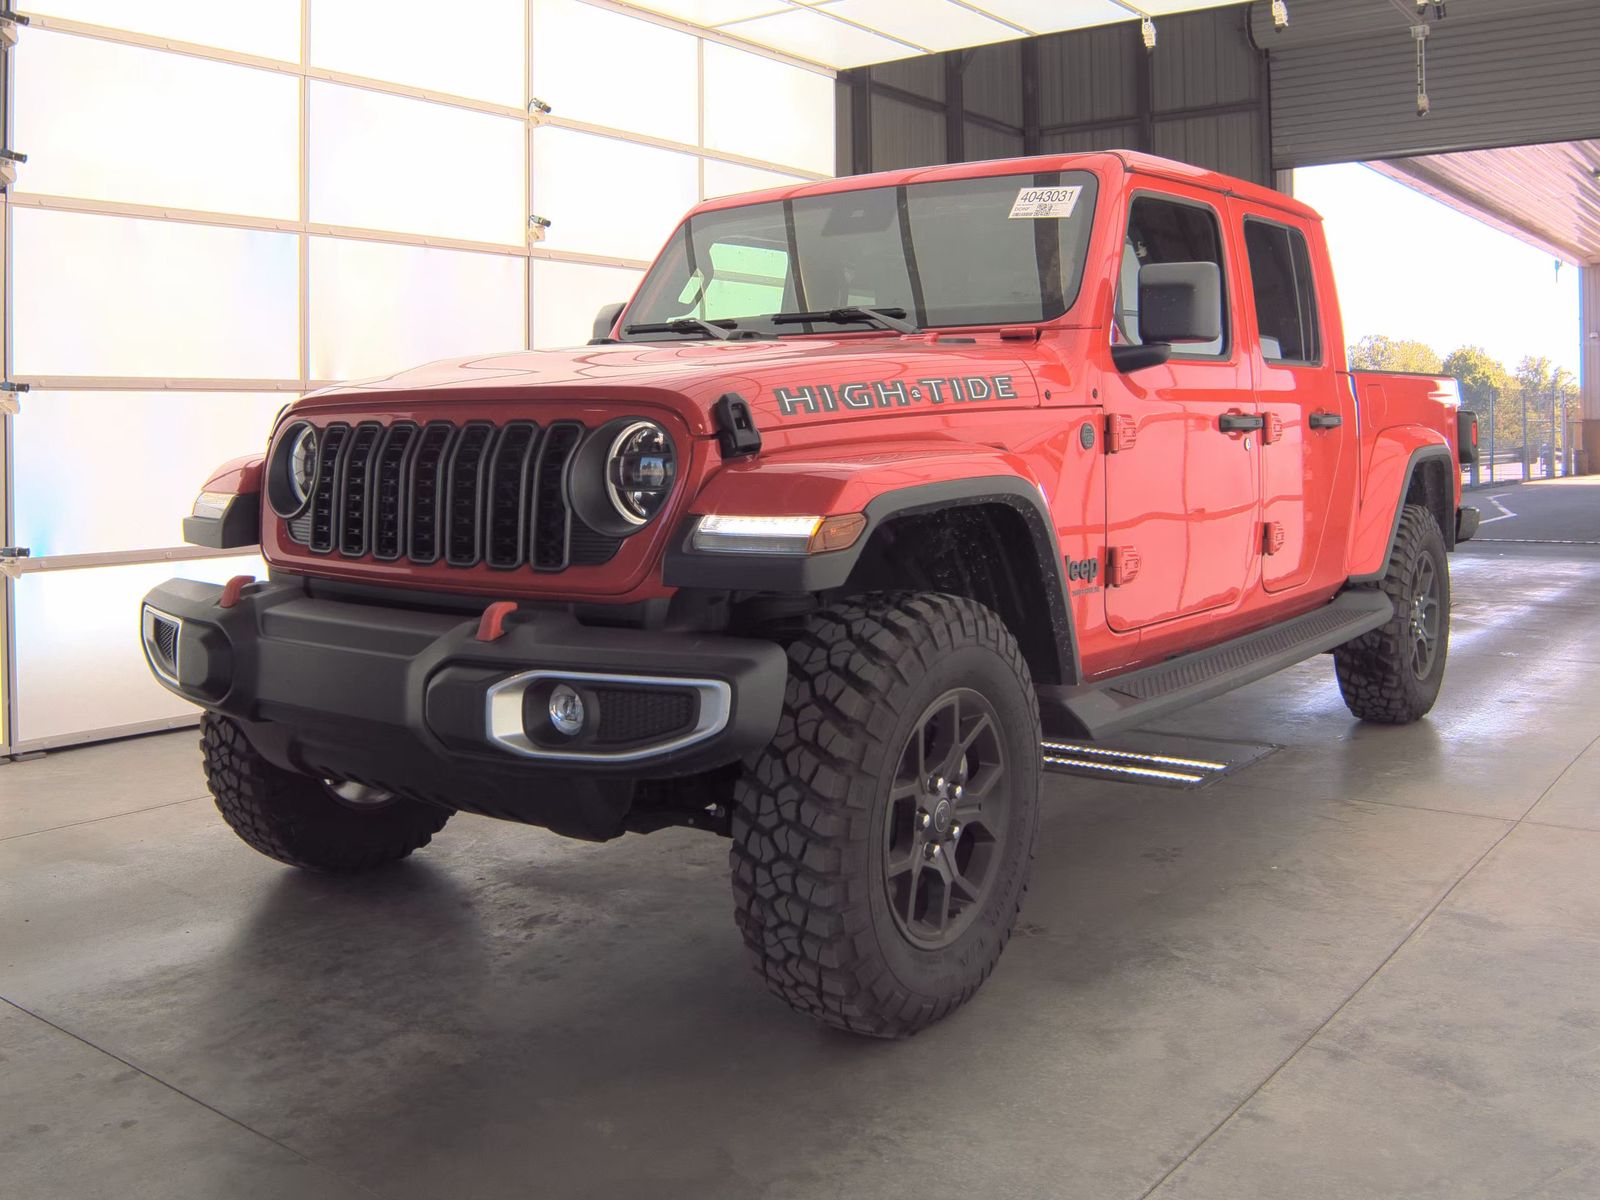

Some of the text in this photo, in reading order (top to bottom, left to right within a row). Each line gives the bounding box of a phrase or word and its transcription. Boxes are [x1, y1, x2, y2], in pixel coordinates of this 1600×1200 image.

[1021, 190, 1075, 203] 4043031
[773, 375, 1018, 416] HIGH TIDE
